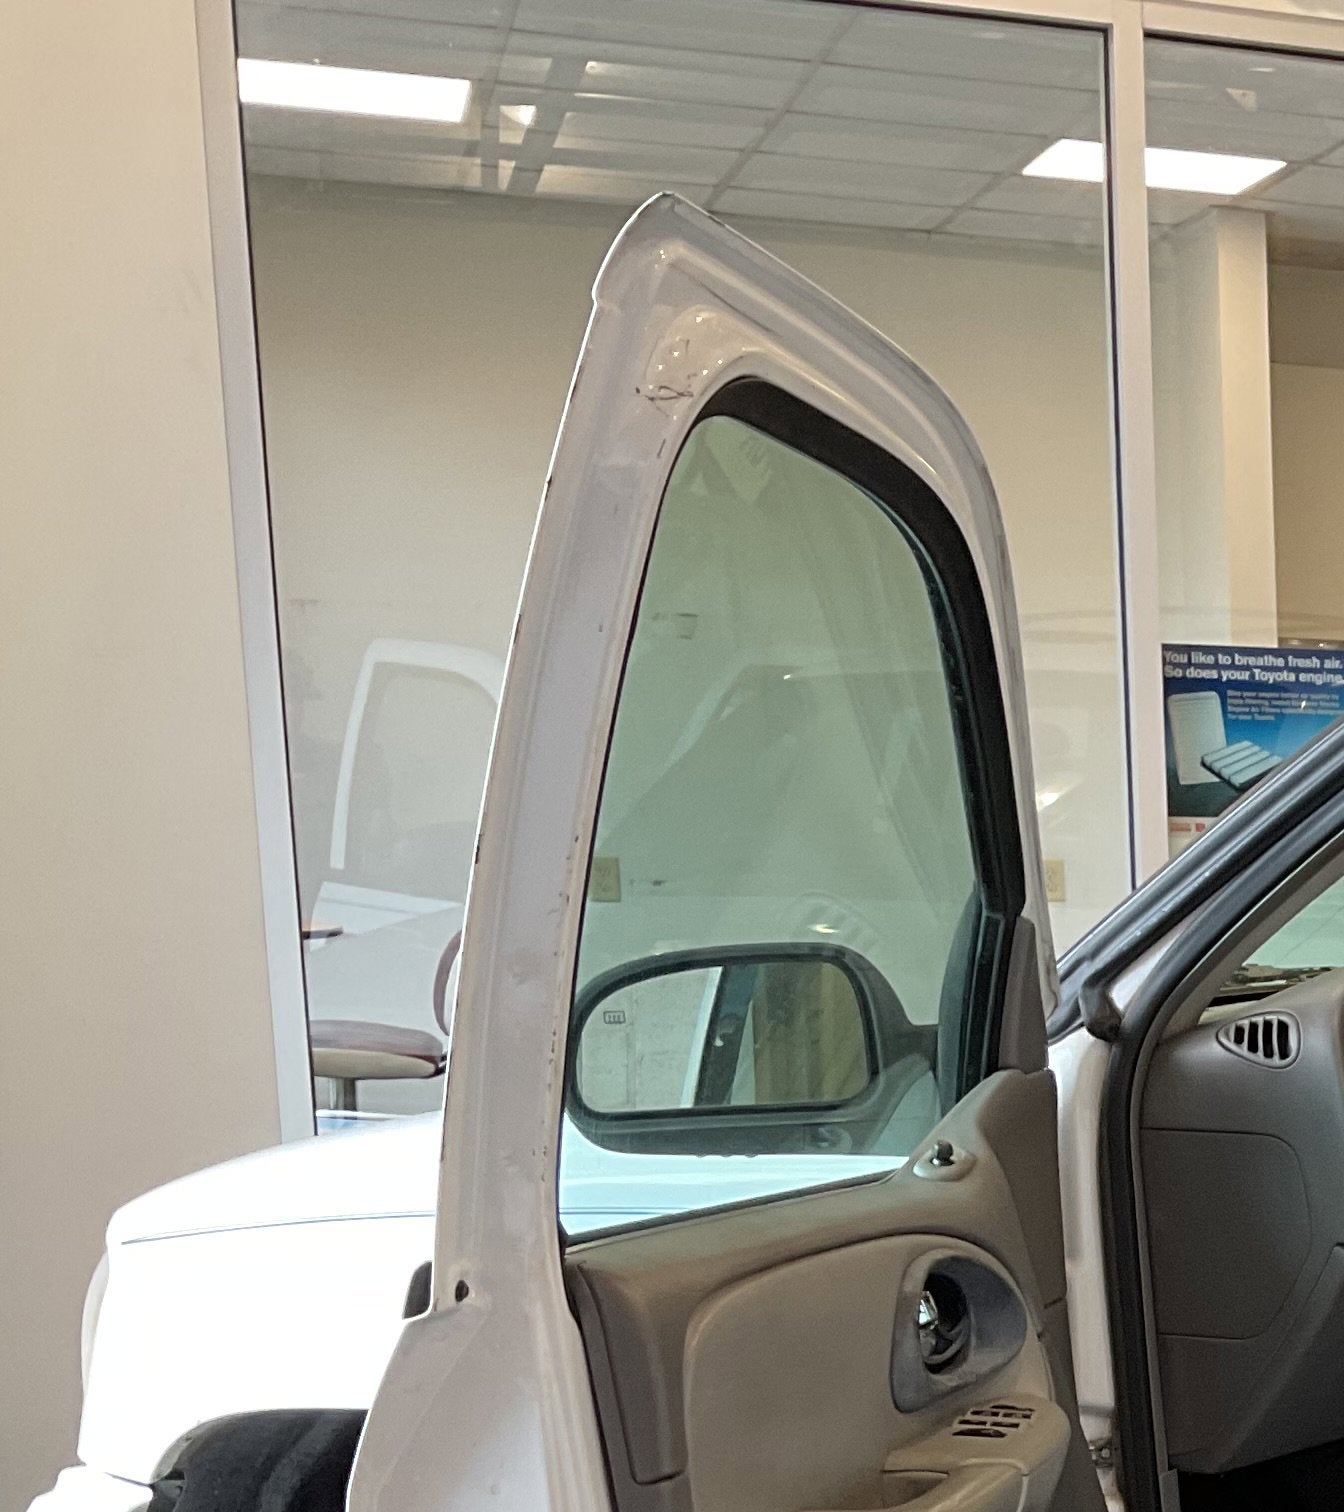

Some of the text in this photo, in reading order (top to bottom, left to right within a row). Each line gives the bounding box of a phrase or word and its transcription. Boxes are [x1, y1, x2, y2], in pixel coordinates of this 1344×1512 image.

[1164, 651, 1343, 669] You like to breathe fresh air.
[1164, 665, 1183, 678] So
[1186, 667, 1219, 679] does
[1221, 669, 1250, 682] your
[1253, 668, 1296, 684] Toyota
